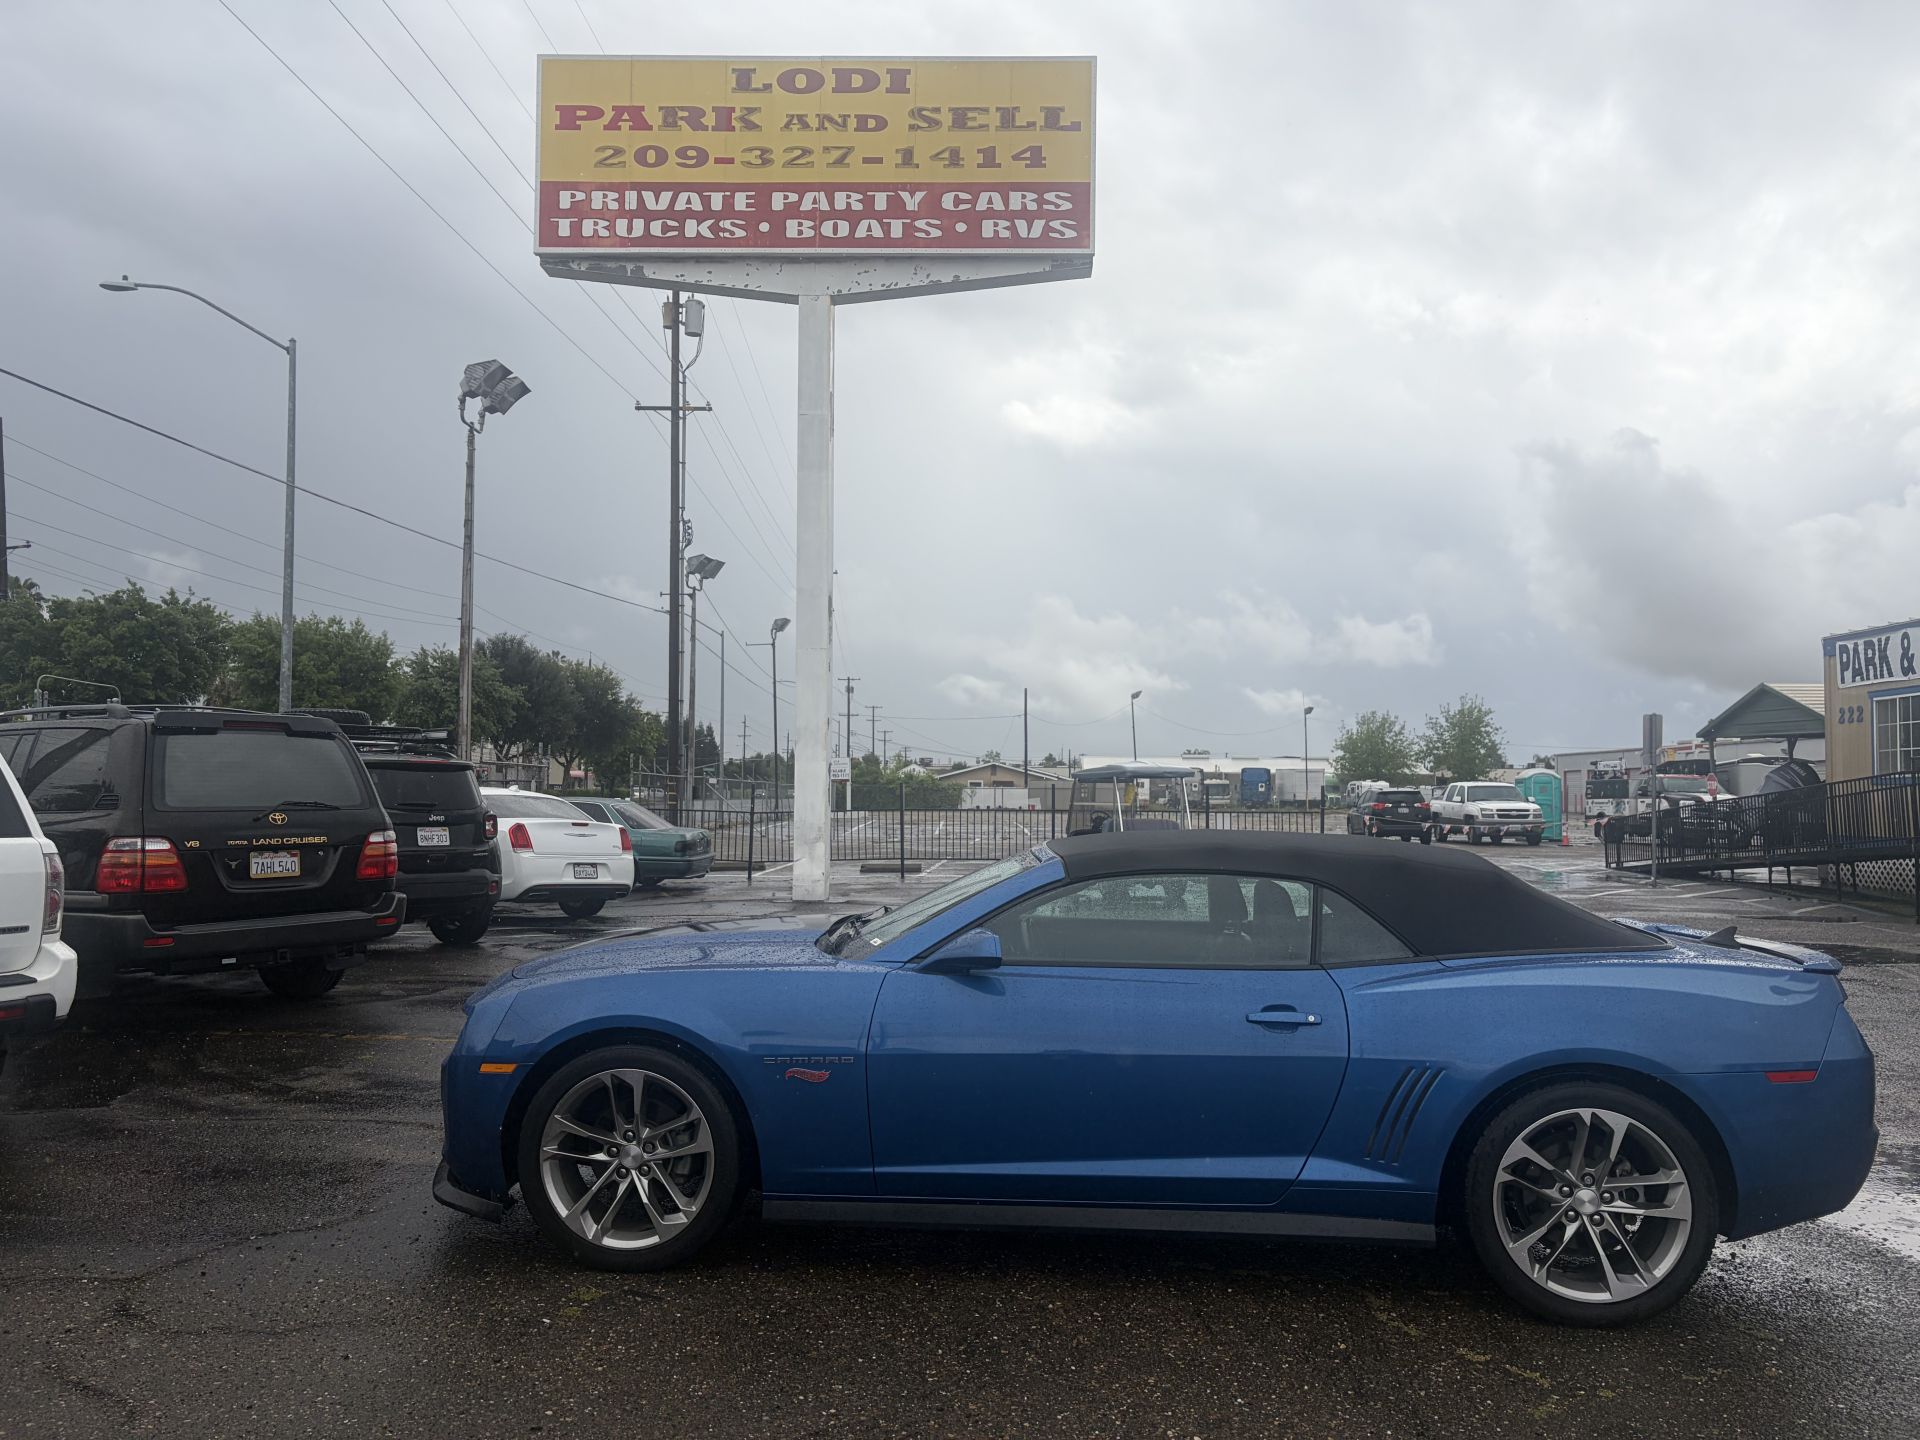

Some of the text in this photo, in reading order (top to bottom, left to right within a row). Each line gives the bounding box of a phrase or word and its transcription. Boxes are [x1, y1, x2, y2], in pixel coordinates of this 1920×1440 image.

[731, 68, 912, 95] LODI
[554, 105, 1082, 133] PARK AND SELL
[593, 145, 1048, 169] 209-327-1414
[559, 190, 1073, 212] PRIVATE PARTY CARS
[550, 218, 1078, 240] TRUCKS BOATS RVS
[1838, 631, 1917, 685] PARK &
[1838, 705, 1864, 725] 222
[428, 814, 445, 822] Jeep
[184, 840, 200, 848] V8
[253, 838, 282, 846] LAND
[283, 836, 328, 845] CRUISER
[253, 860, 297, 875] 7AHL540
